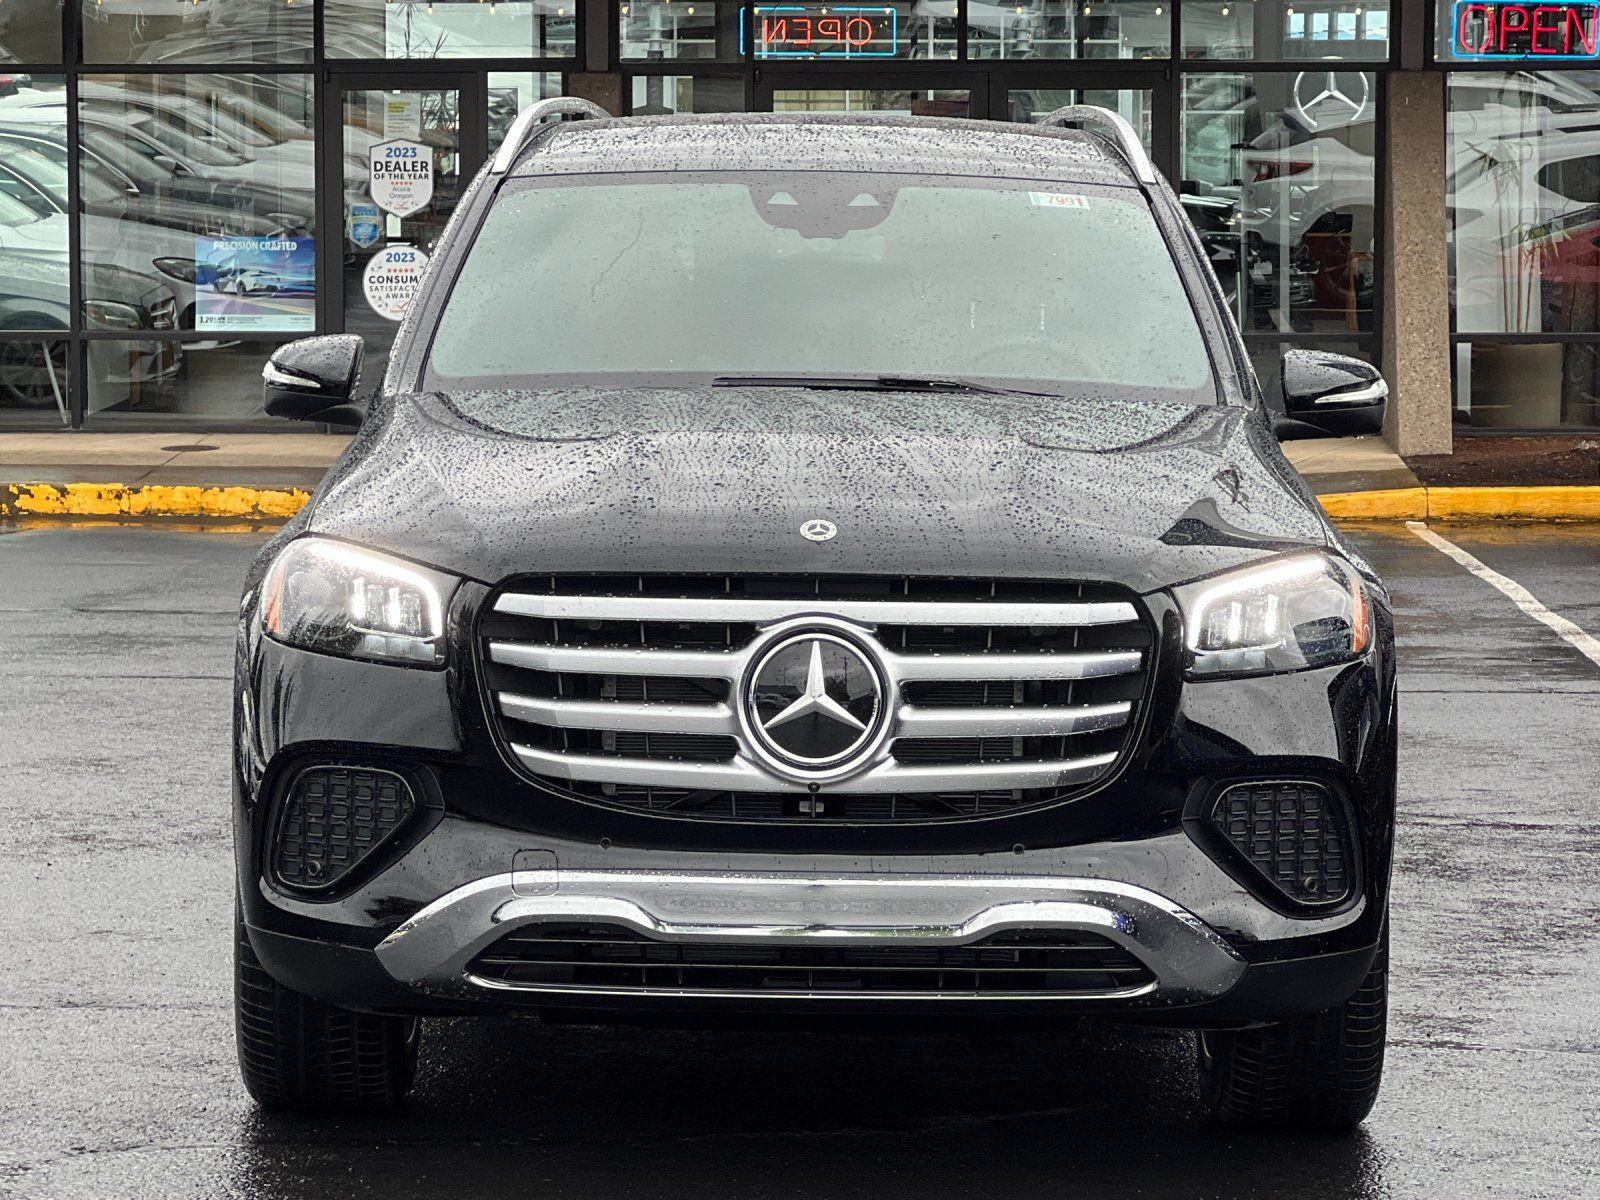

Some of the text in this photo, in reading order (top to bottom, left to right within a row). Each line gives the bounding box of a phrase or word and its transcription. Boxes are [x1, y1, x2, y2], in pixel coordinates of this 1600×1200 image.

[1460, 5, 1598, 55] OPEN
[386, 147, 417, 158] 2023
[373, 161, 429, 172] DEALER
[213, 240, 298, 250] PRECISION CRAFTED
[386, 252, 415, 262] 2023
[368, 275, 422, 284] CONSUM
